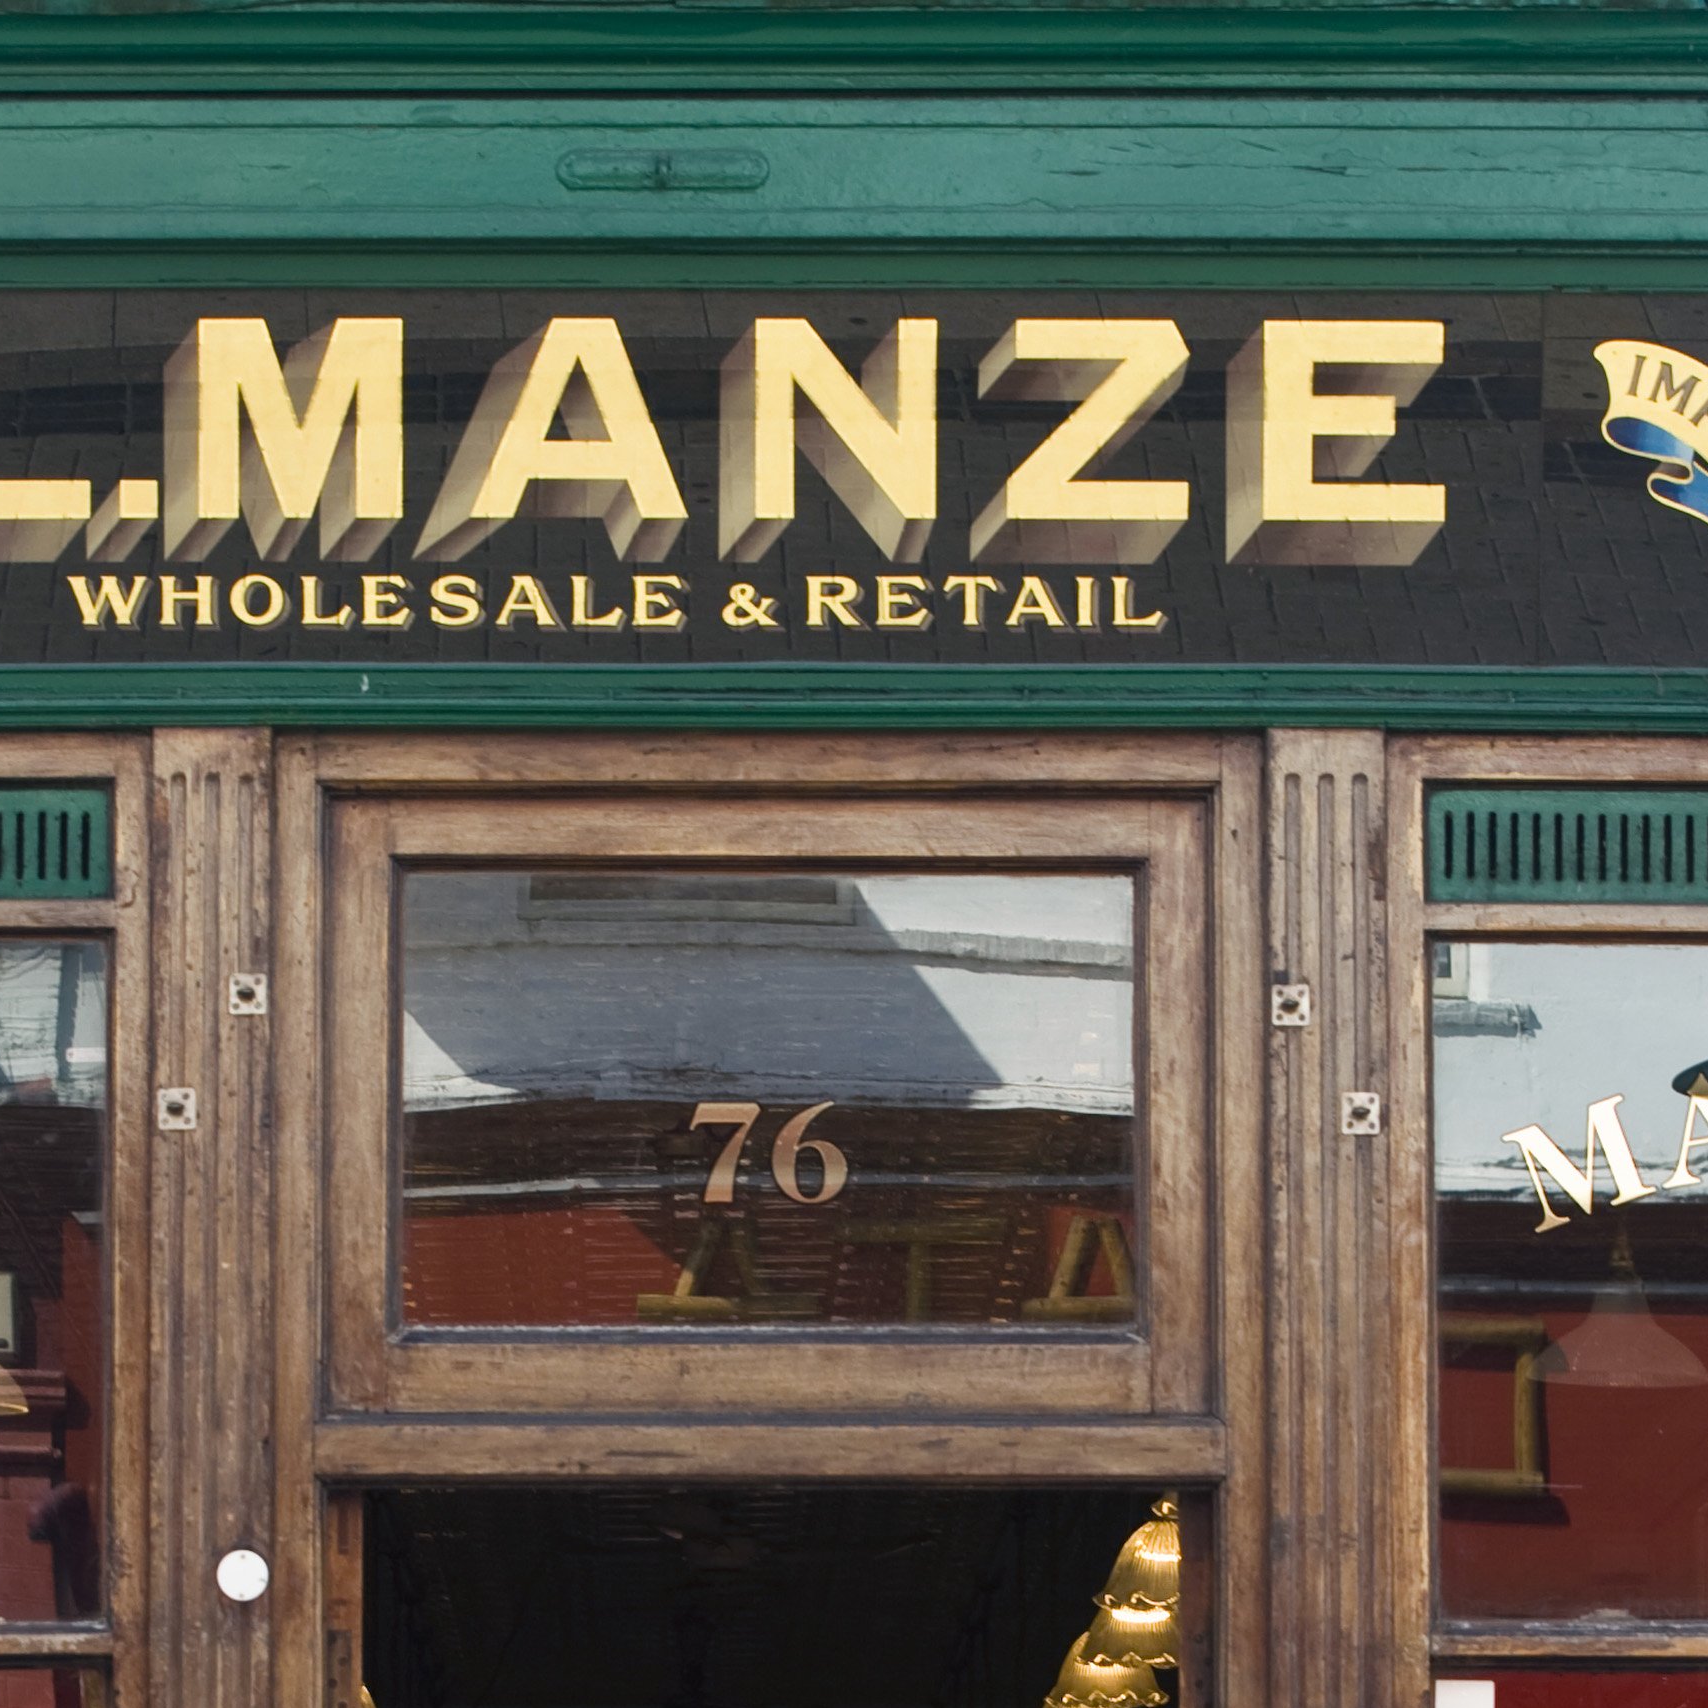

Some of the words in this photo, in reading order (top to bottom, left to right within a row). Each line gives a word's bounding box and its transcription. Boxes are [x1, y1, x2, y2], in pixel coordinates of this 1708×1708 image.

[67, 574, 687, 631] WHOLESALE
[723, 578, 774, 630] &
[804, 573, 1167, 631] RETAIL
[689, 1101, 848, 1204] 76
